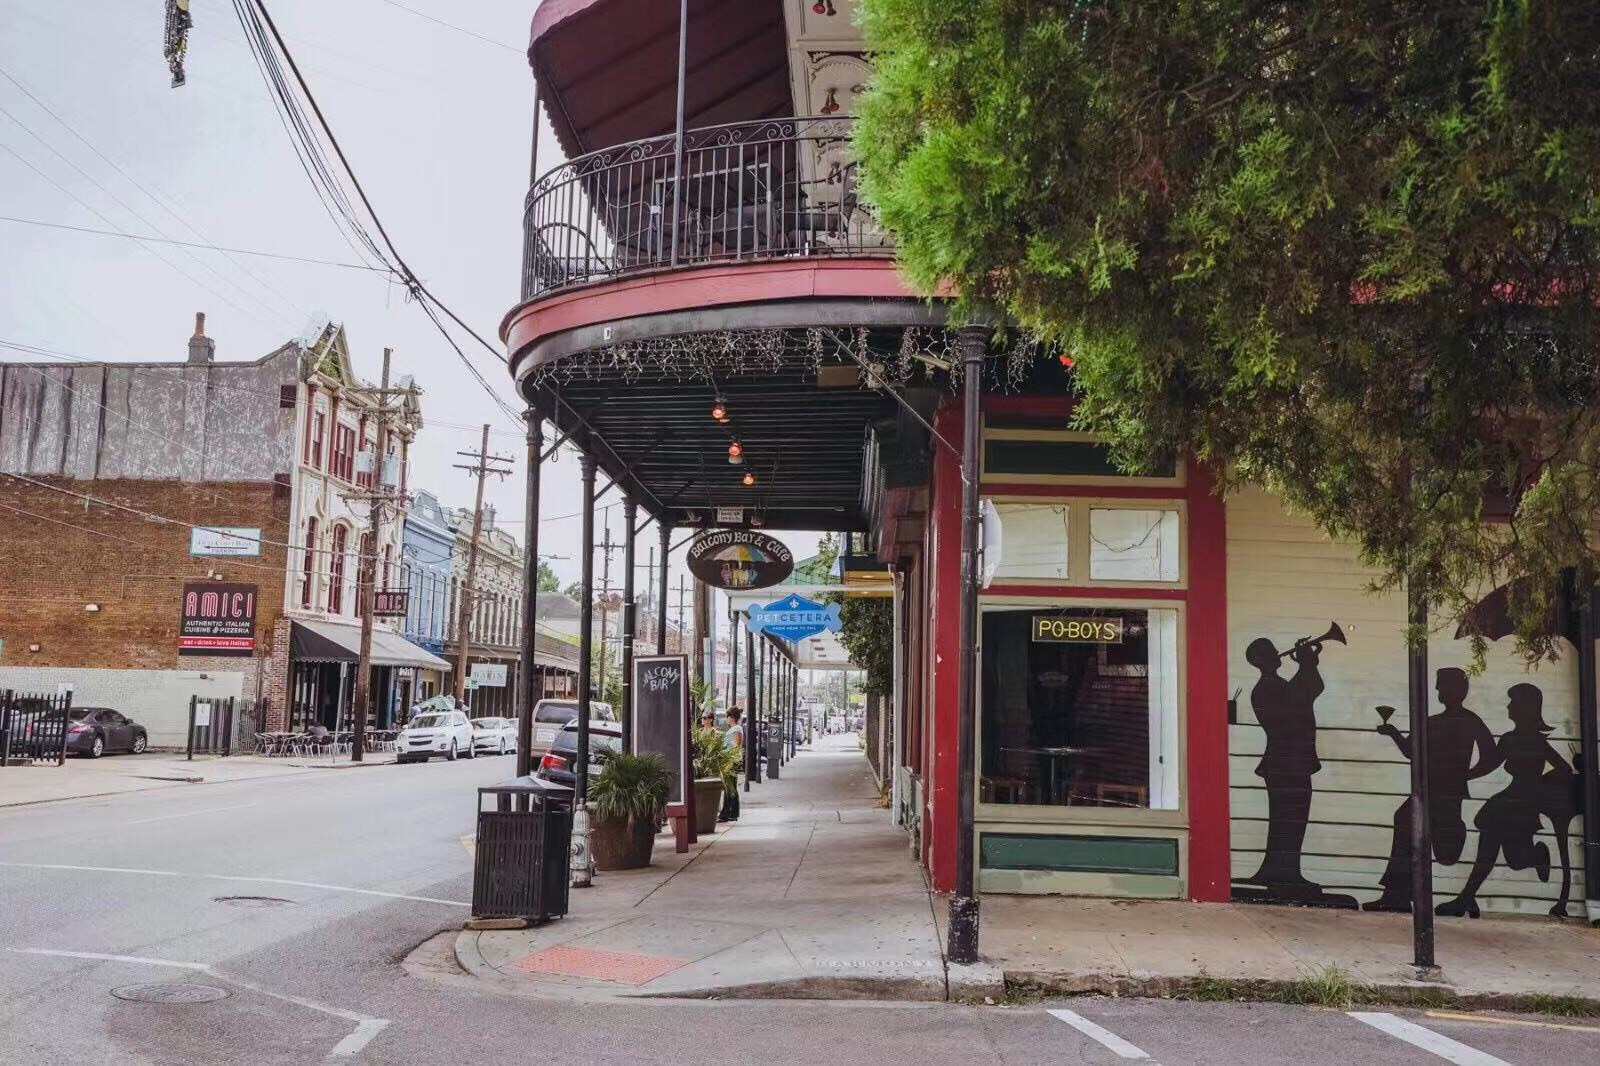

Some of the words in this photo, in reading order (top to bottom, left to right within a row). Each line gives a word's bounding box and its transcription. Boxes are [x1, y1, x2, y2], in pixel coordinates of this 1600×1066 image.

[734, 532, 756, 543] Bar
[754, 534, 764, 547] &
[185, 591, 253, 618] AMICI
[377, 594, 408, 610] MICI
[756, 613, 832, 623] PETCETERA
[650, 678, 669, 690] BAR
